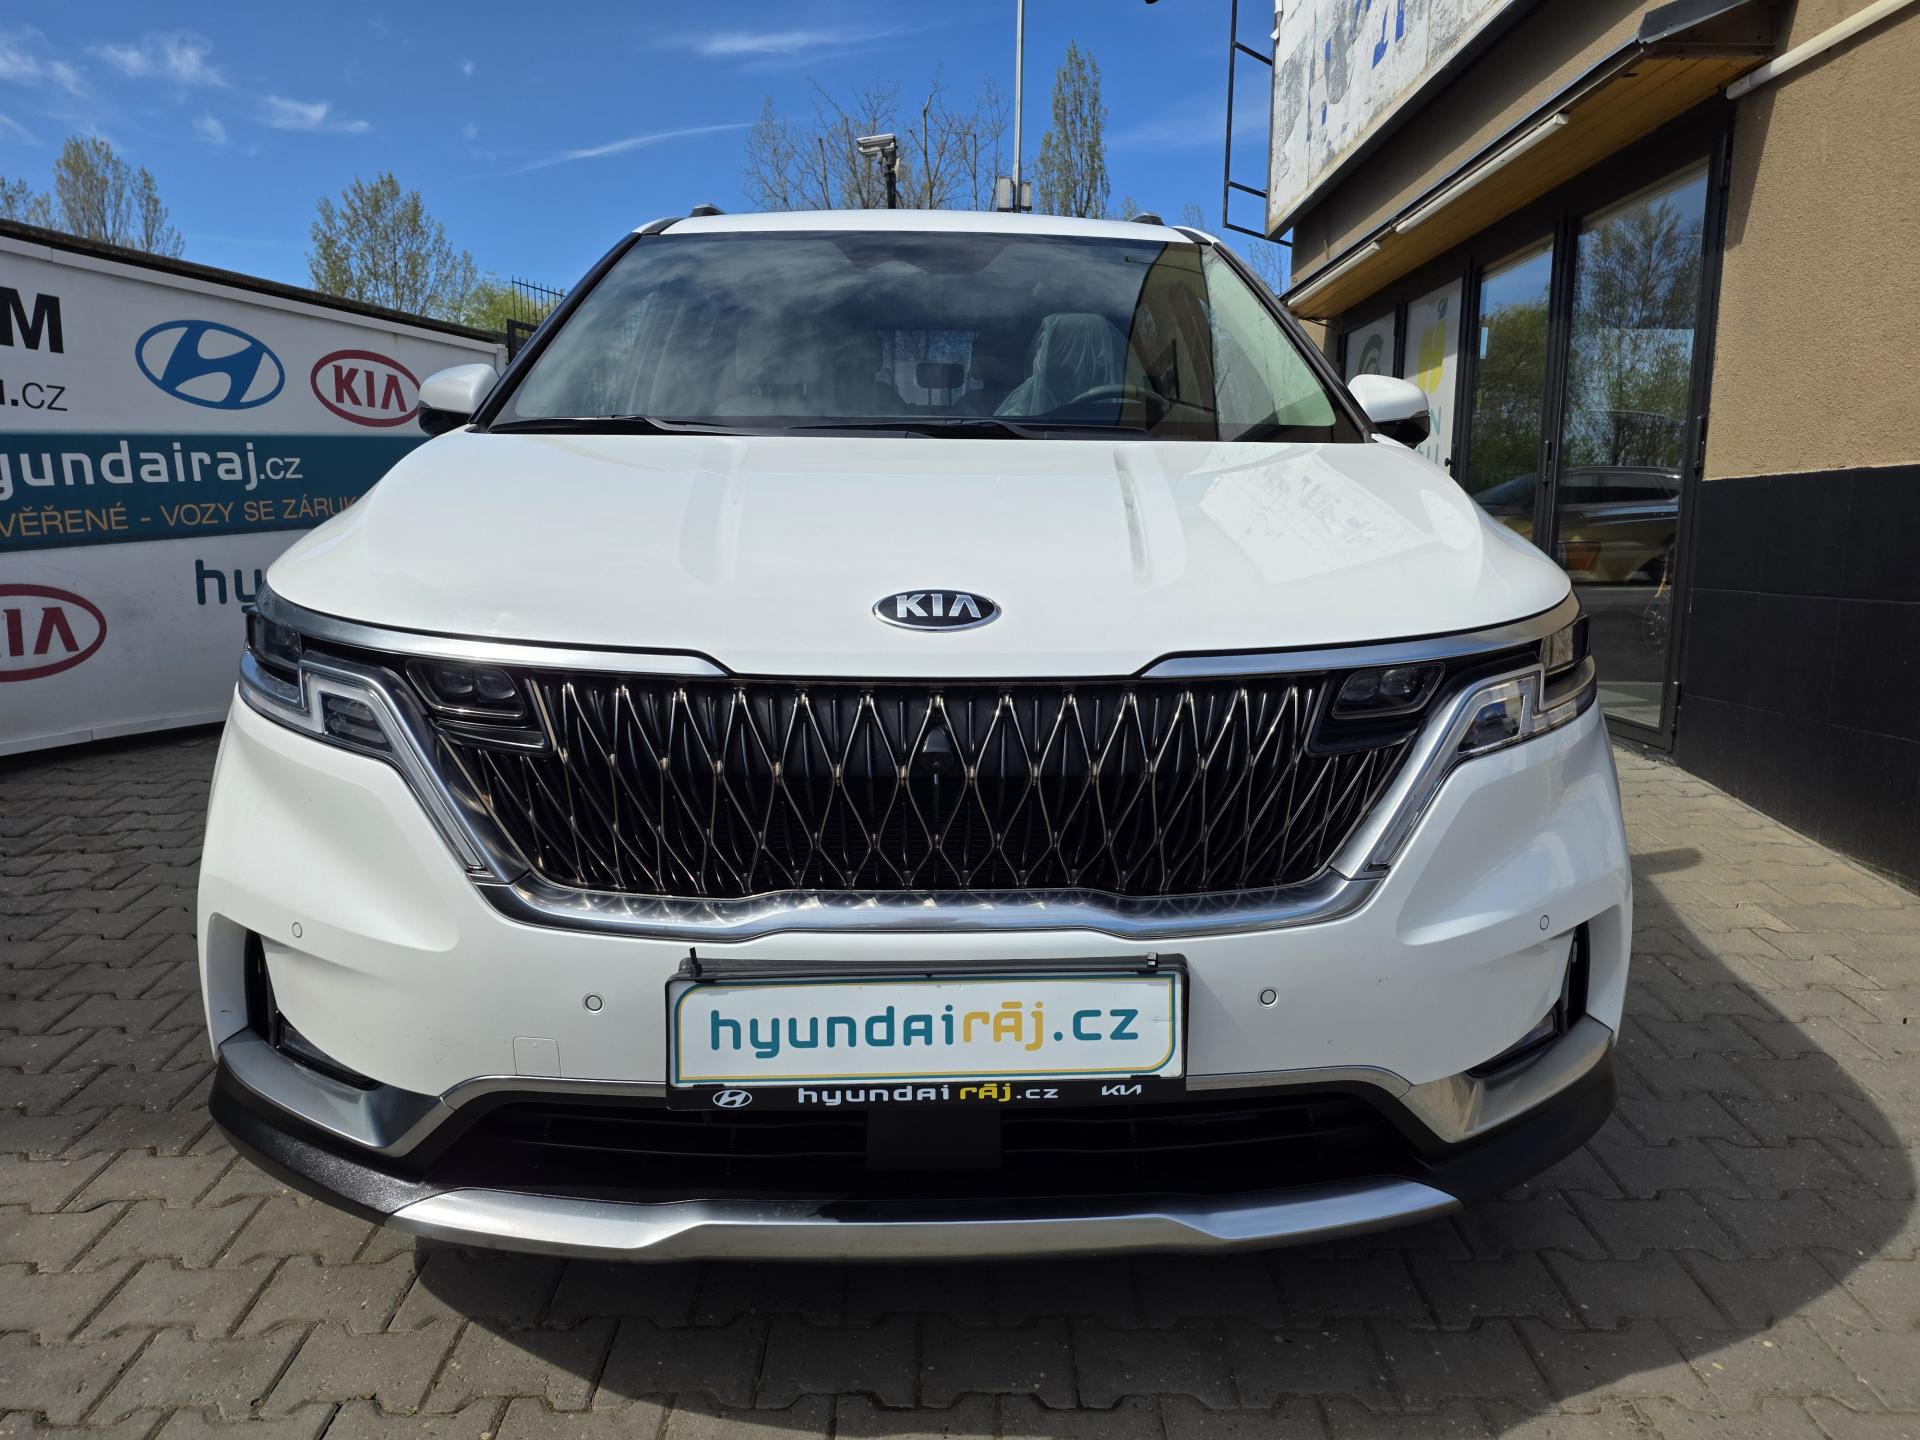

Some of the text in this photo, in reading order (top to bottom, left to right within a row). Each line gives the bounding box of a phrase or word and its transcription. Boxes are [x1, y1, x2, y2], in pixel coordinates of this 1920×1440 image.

[0, 286, 64, 354] M
[0, 378, 68, 412] .cz
[333, 364, 407, 412] KIA
[160, 502, 234, 527] VOZY
[244, 501, 274, 521] SE
[895, 593, 982, 618] KIA
